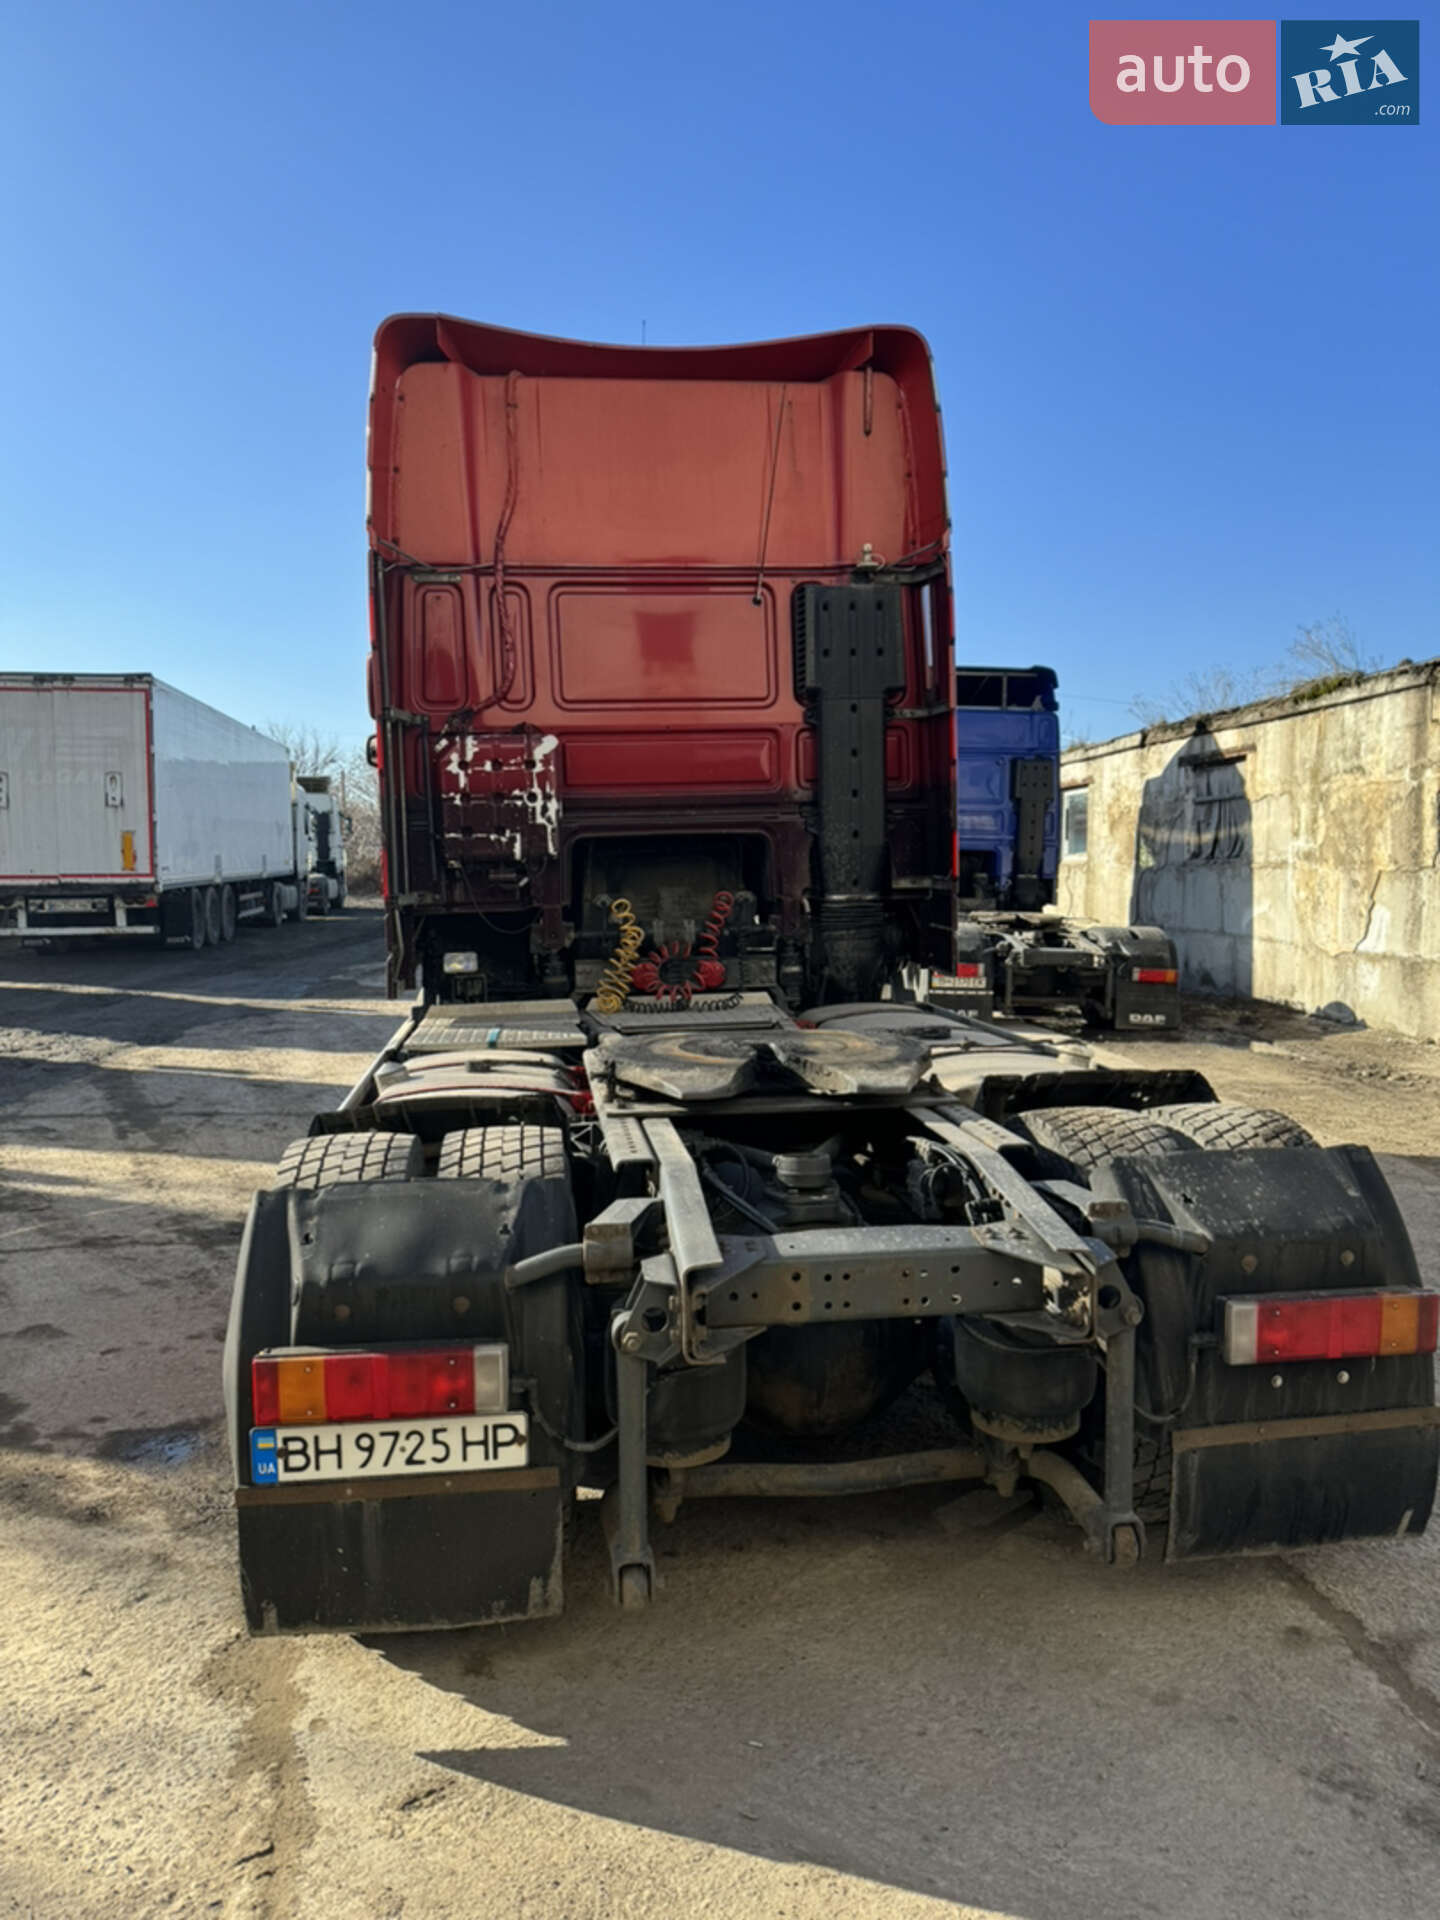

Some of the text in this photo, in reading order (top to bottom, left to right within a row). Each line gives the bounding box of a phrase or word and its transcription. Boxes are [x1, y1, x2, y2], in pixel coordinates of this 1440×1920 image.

[1129, 1013, 1166, 1025] DAF
[282, 1423, 520, 1473] BH 9725 HP
[258, 1462, 276, 1475] UA
